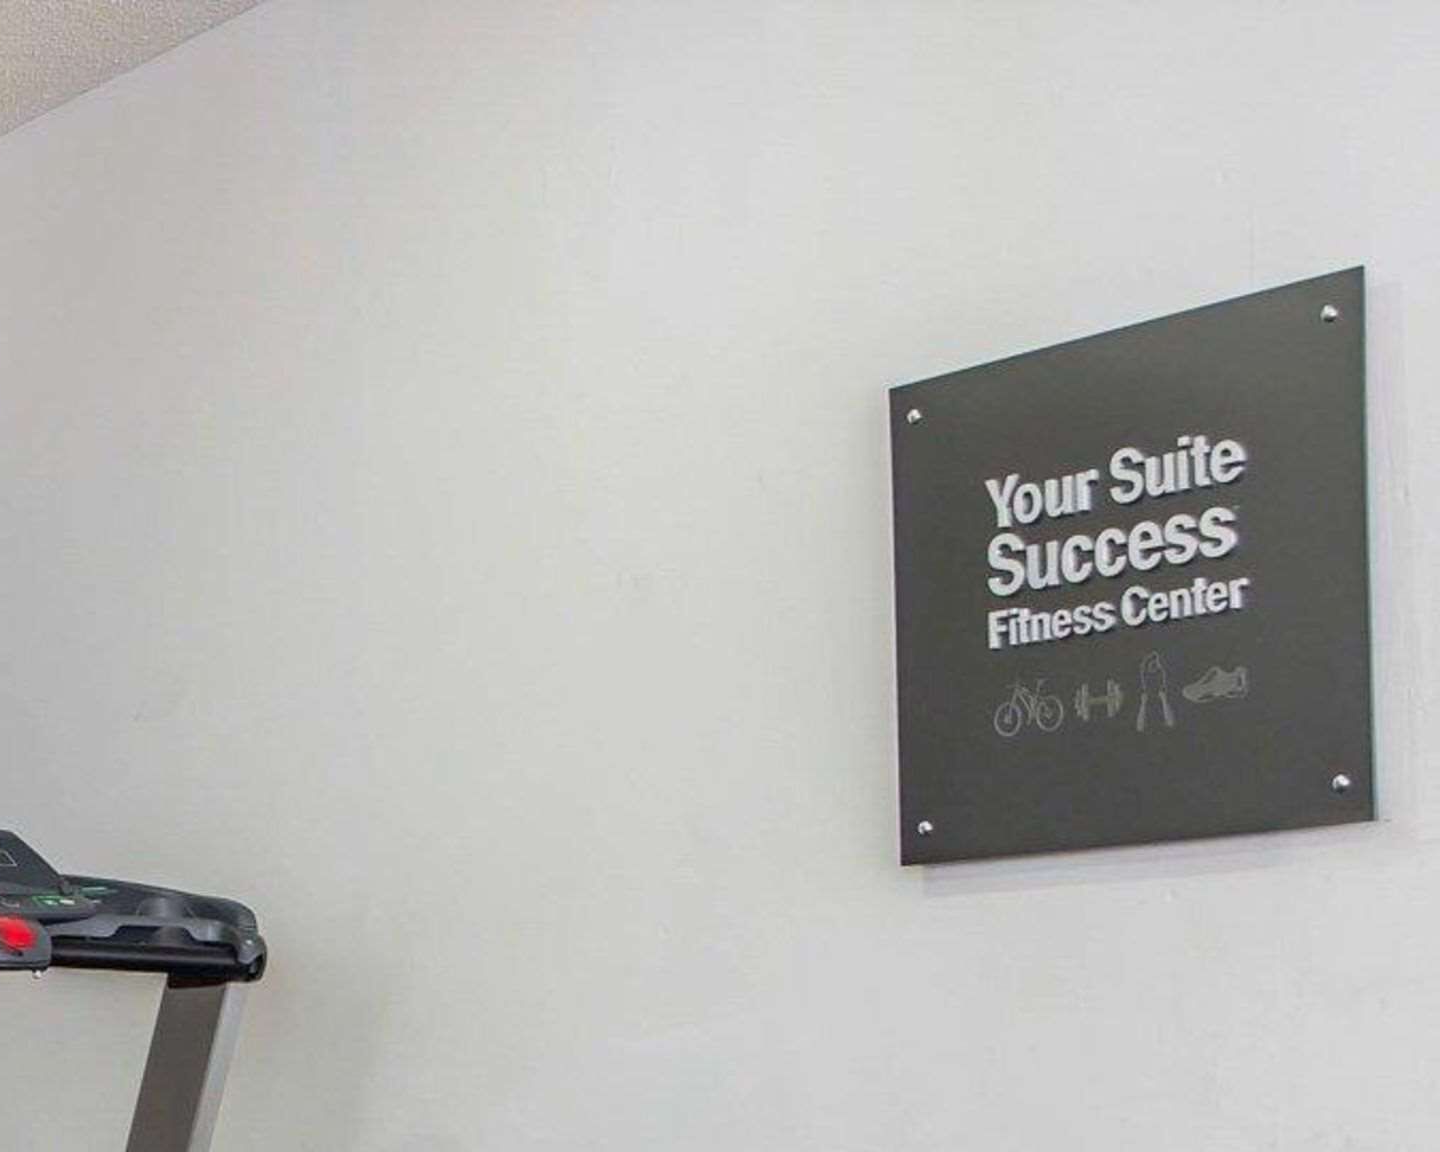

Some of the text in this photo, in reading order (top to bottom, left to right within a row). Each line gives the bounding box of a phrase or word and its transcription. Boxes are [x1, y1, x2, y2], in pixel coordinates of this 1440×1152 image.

[985, 435, 1246, 528] Your Suite
[988, 506, 1238, 597] Success
[988, 577, 1250, 649] Fitness Center
